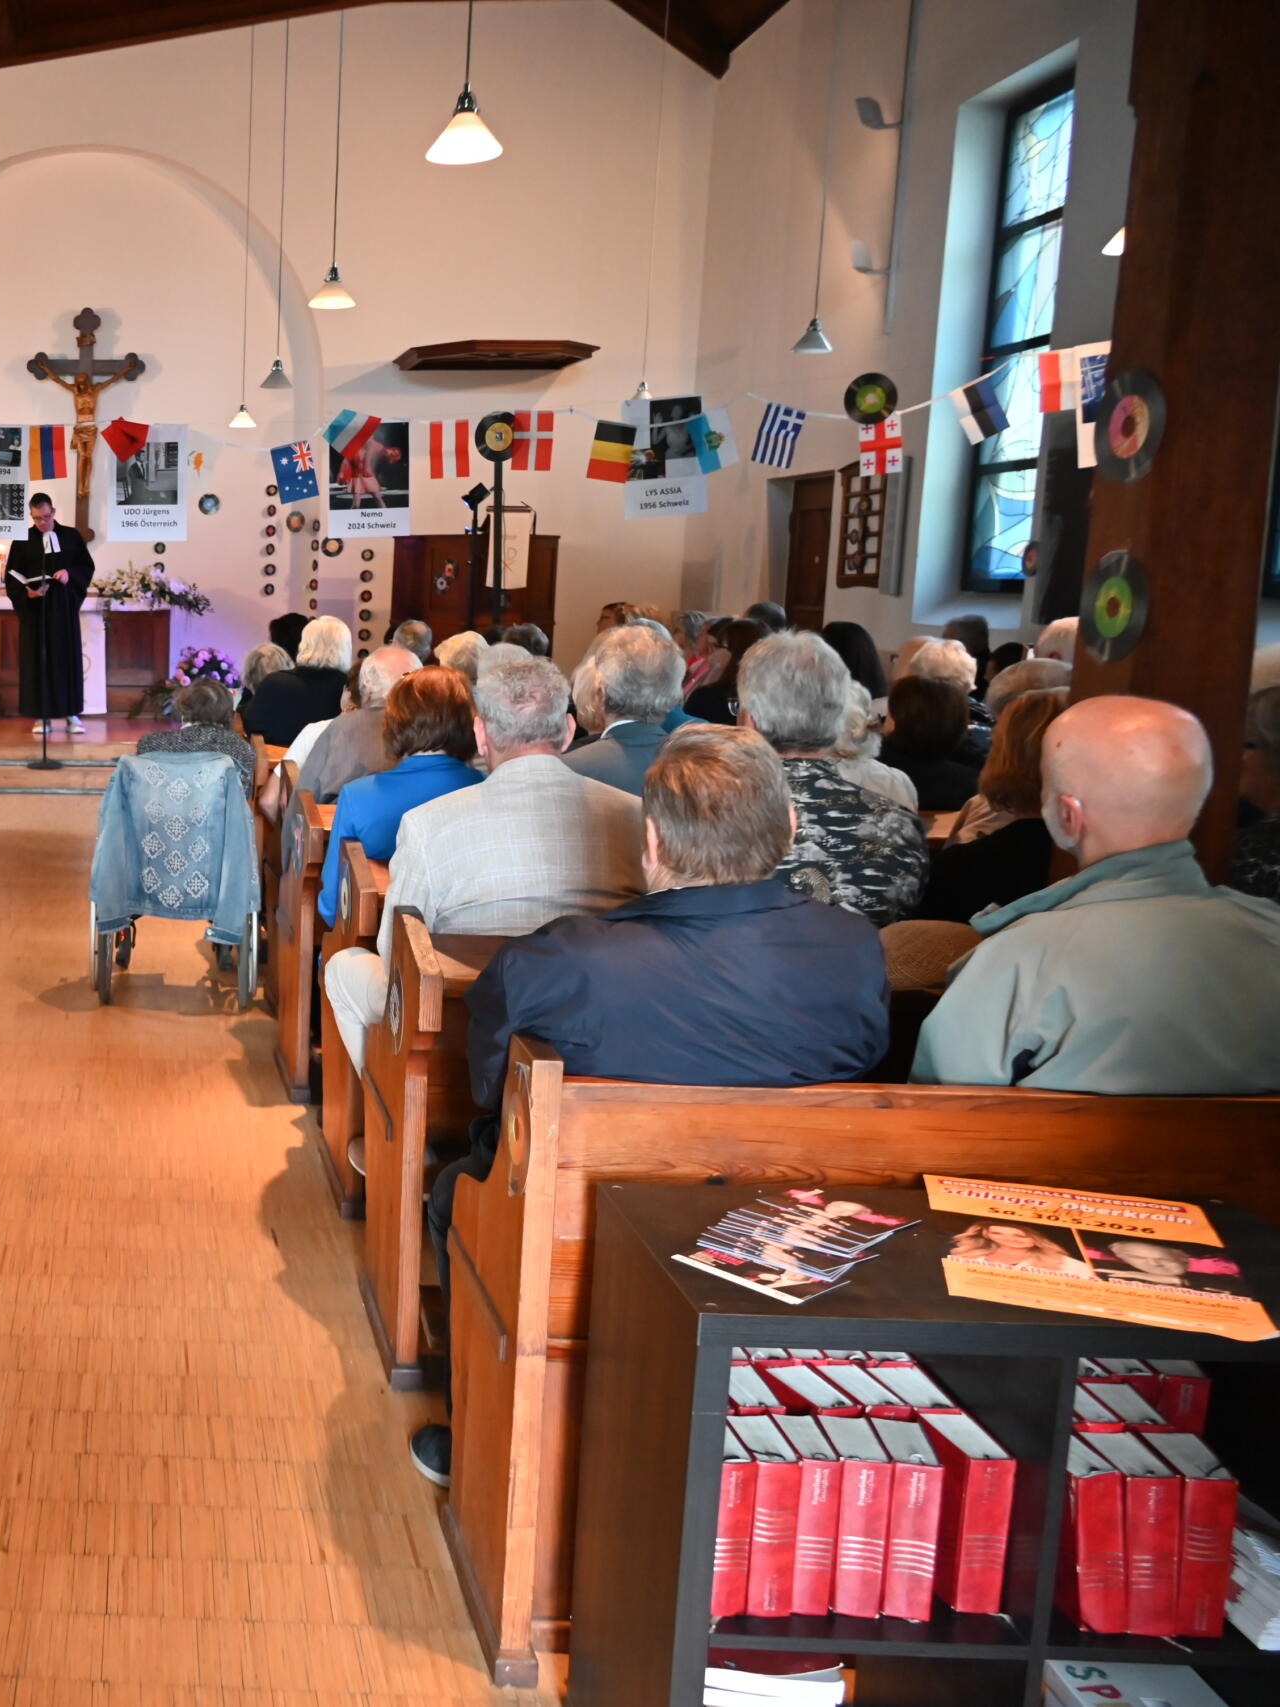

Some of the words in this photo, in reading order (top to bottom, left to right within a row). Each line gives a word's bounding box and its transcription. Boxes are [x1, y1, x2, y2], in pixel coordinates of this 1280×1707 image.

[645, 488, 658, 497] LYS
[660, 486, 682, 496] ASSIA
[640, 502, 657, 510] 1956
[659, 499, 690, 508] Schweiz
[142, 508, 170, 516] Jürgens
[140, 519, 178, 527] Österreich
[347, 522, 365, 530] 2024
[367, 521, 397, 529] Schweiz
[941, 1186, 1049, 1206] Schlager
[1059, 1200, 1194, 1226] Oberkrain
[1075, 1194, 1182, 1212] HITZENDORF
[1033, 1213, 1156, 1235] 30.5.2026
